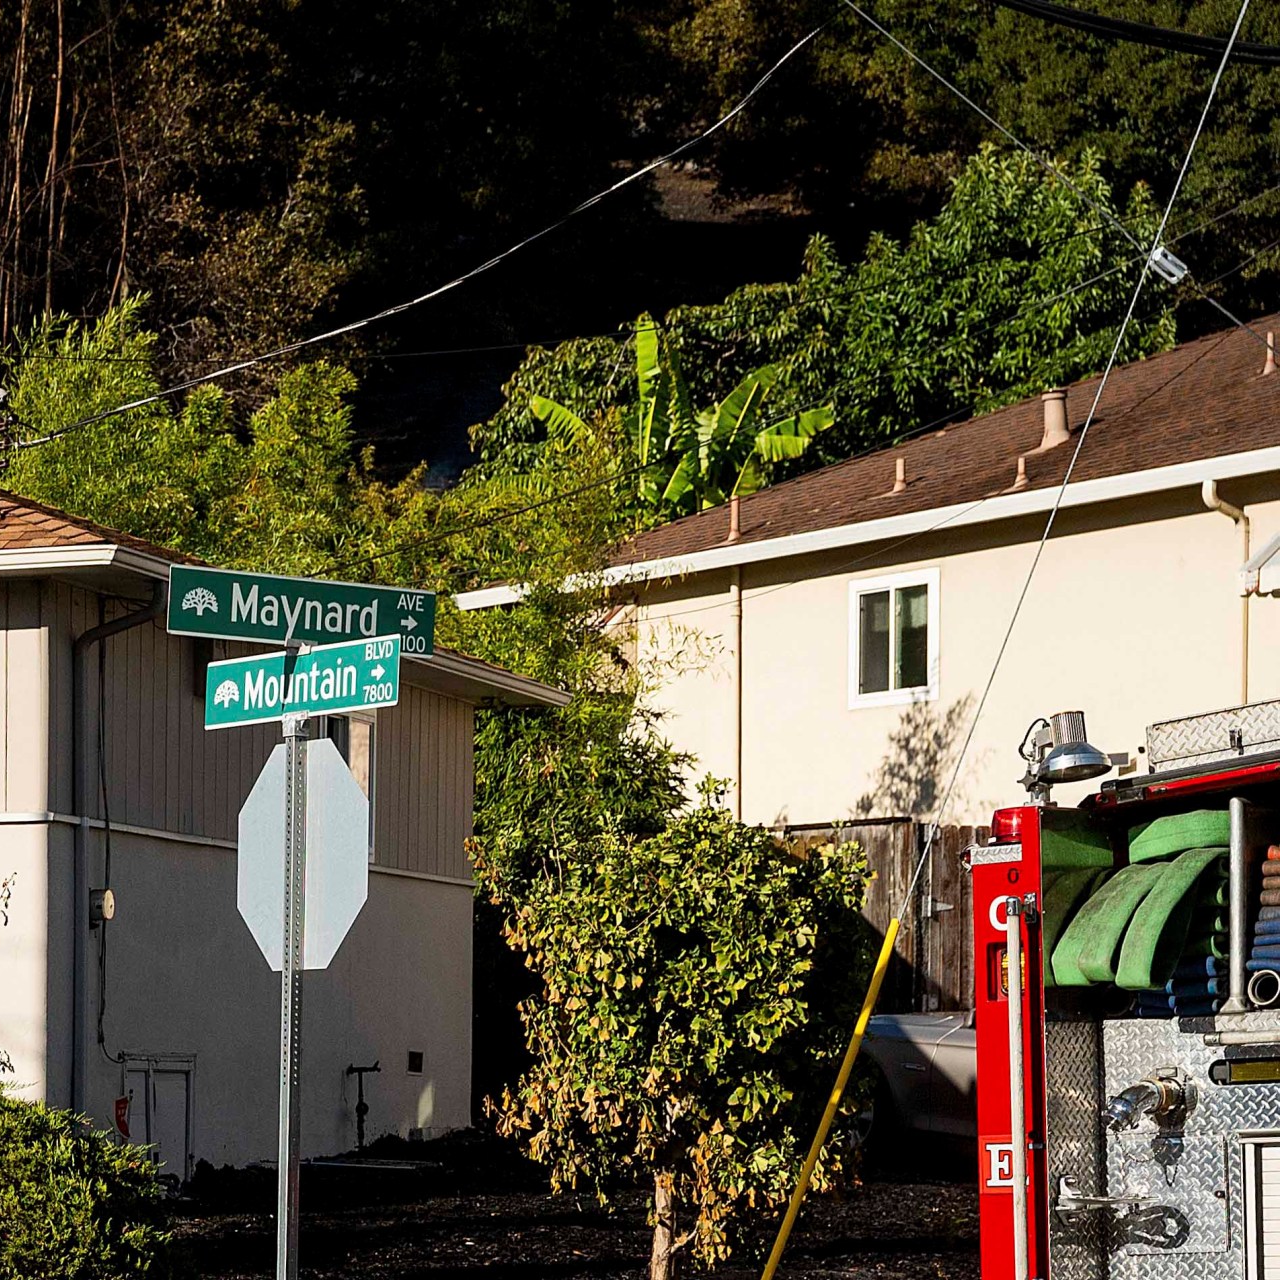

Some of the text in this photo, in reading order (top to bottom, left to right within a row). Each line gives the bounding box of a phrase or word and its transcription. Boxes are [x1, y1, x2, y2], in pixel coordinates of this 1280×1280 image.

[396, 593, 425, 612] AVE
[230, 582, 379, 646] Maynard
[365, 641, 394, 661] BLVD
[402, 635, 426, 653] 100
[243, 658, 358, 711] Mountain
[362, 682, 393, 703] 7800
